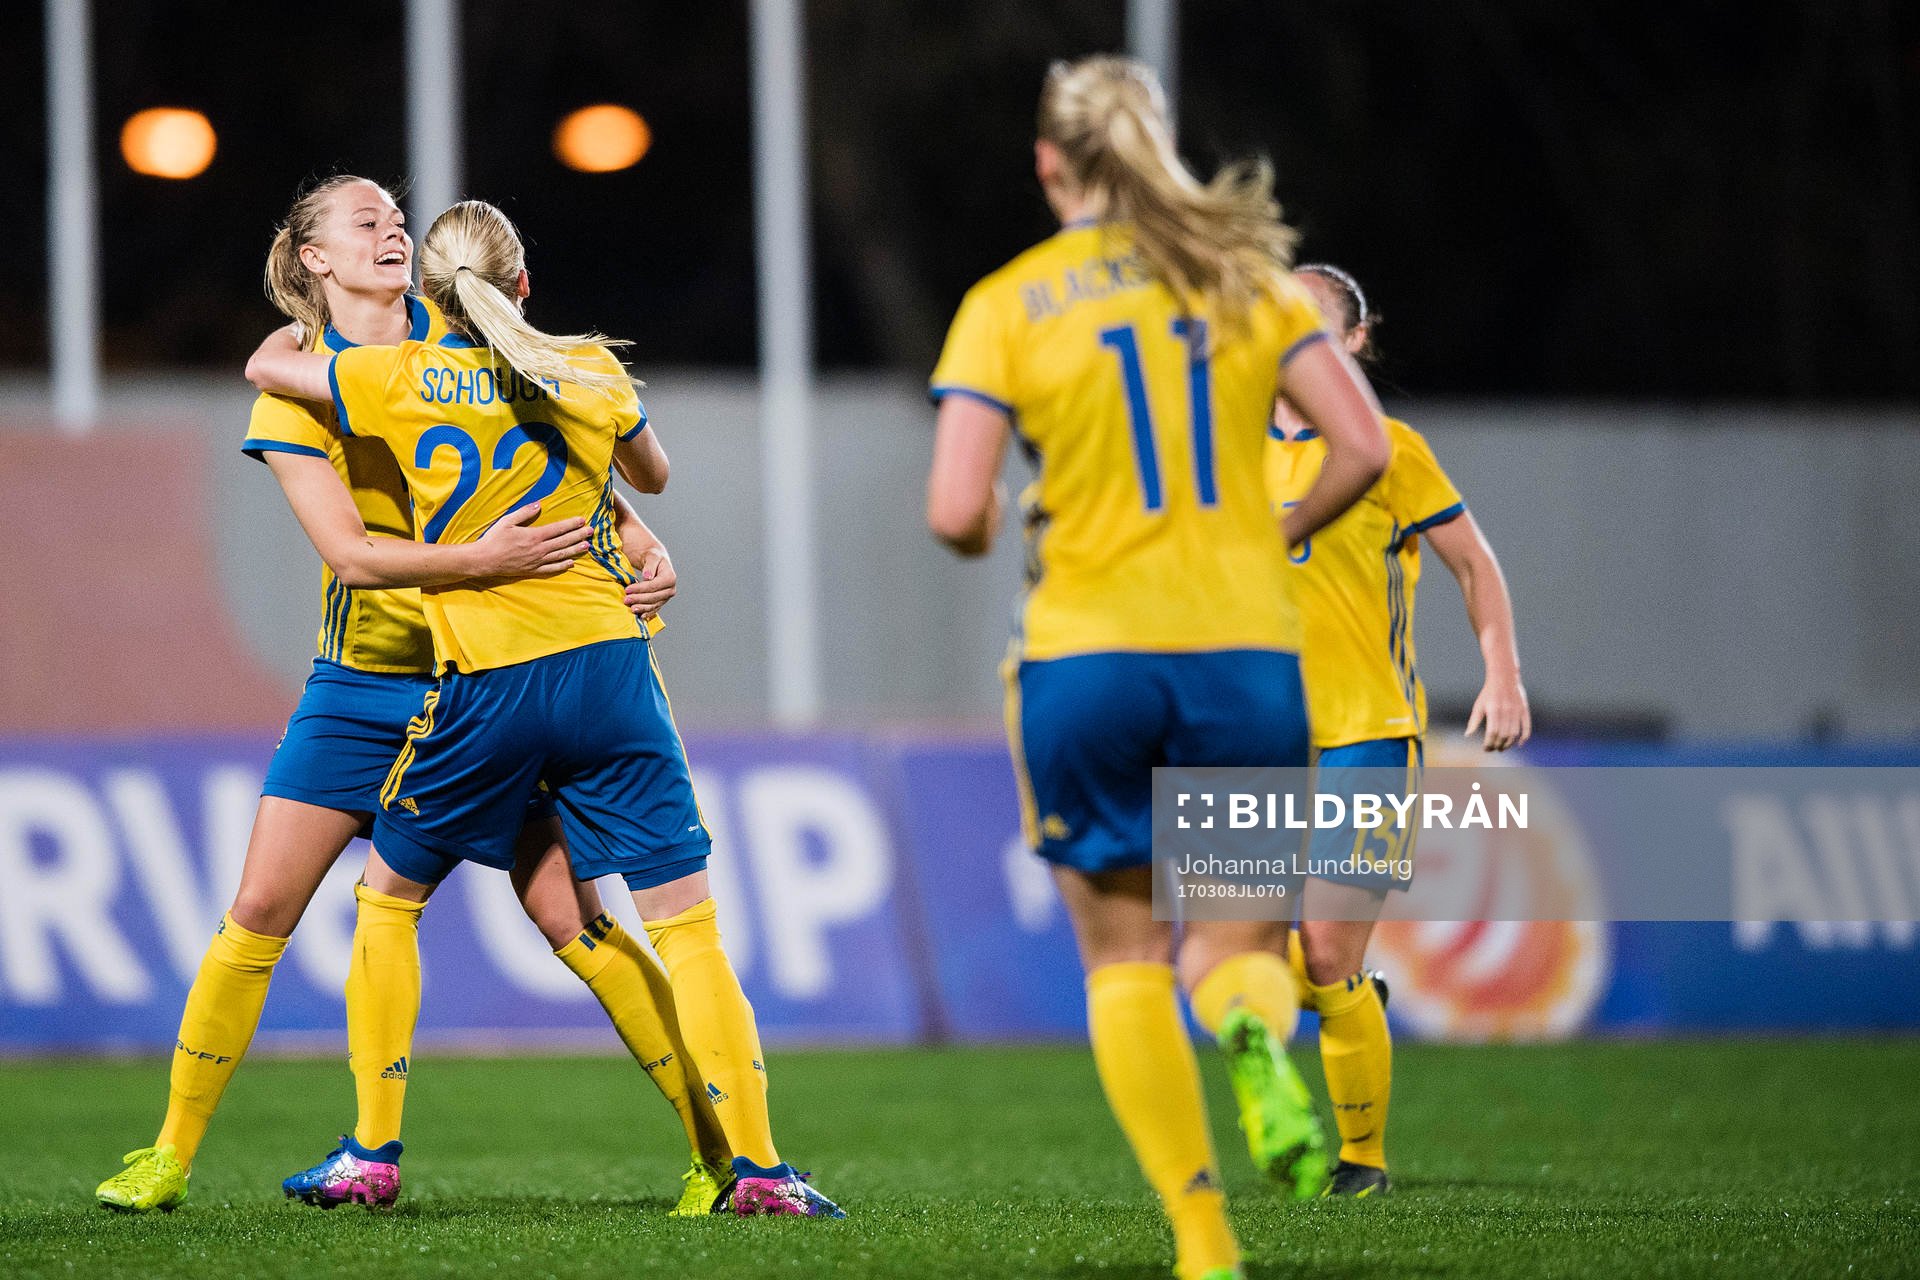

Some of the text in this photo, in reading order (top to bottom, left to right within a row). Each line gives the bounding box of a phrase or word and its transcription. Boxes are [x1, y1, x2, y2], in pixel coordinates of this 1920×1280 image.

[1019, 254, 1152, 323] BLACKS
[1099, 319, 1217, 511] 11
[414, 422, 568, 544] 22
[645, 1053, 673, 1071] FF
